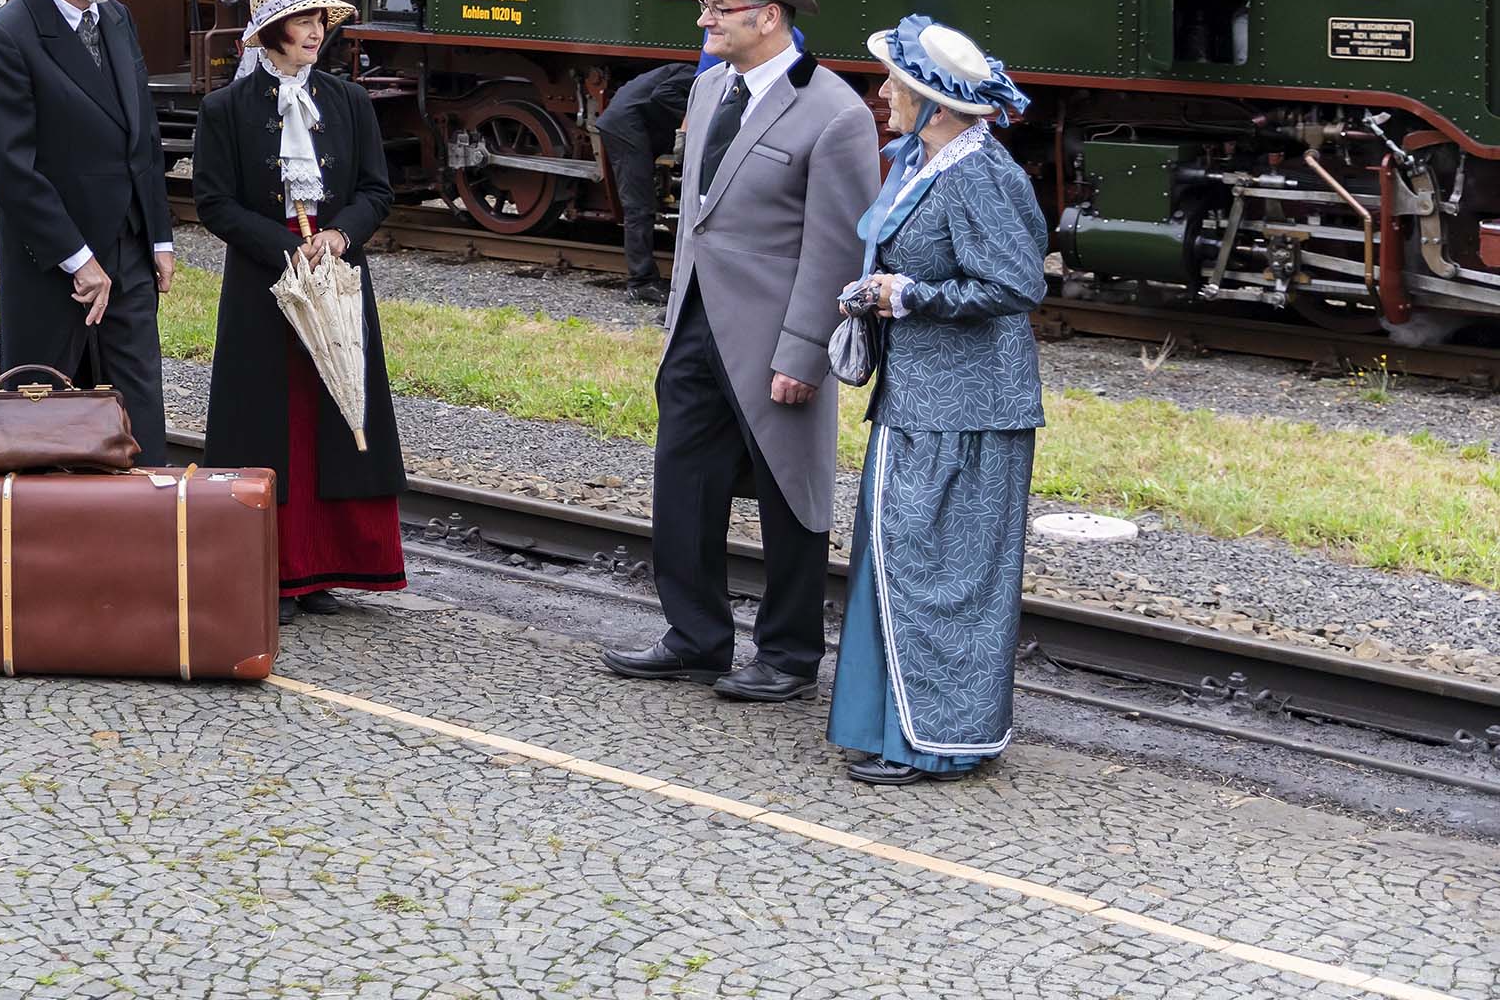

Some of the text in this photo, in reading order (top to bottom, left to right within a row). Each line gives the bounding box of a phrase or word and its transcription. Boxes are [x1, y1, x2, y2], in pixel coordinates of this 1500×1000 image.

[462, 5, 522, 25] Kohlen 1020 kg
